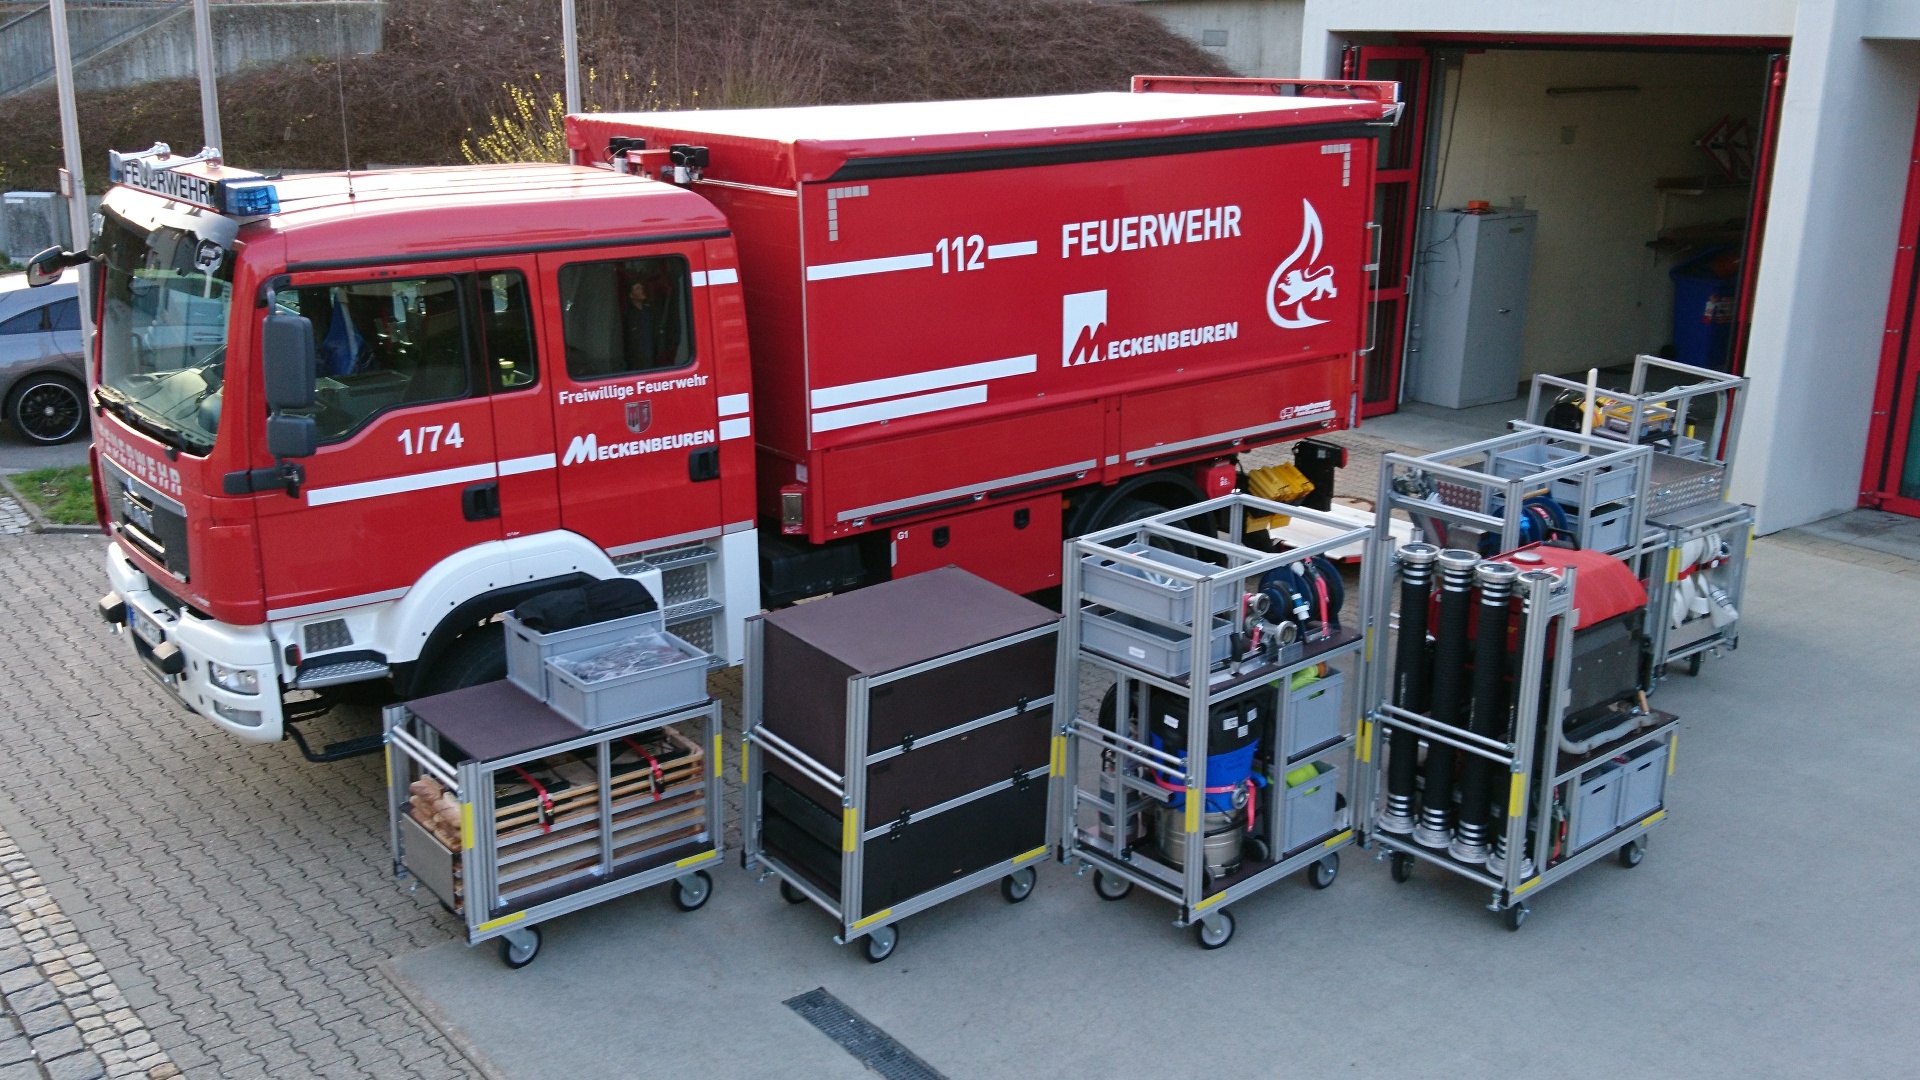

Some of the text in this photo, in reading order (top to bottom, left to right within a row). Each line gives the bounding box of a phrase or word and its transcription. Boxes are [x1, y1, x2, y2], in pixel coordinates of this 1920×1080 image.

[1062, 205, 1241, 259] FEUERWEHR
[935, 234, 985, 274] 112
[1066, 321, 1238, 367] MECKENBEUREN
[558, 374, 709, 405] Freiwillige Feuerwehr
[397, 422, 465, 456] 1/74
[562, 429, 715, 467] MECKENBEUREN
[897, 530, 909, 541] G1
